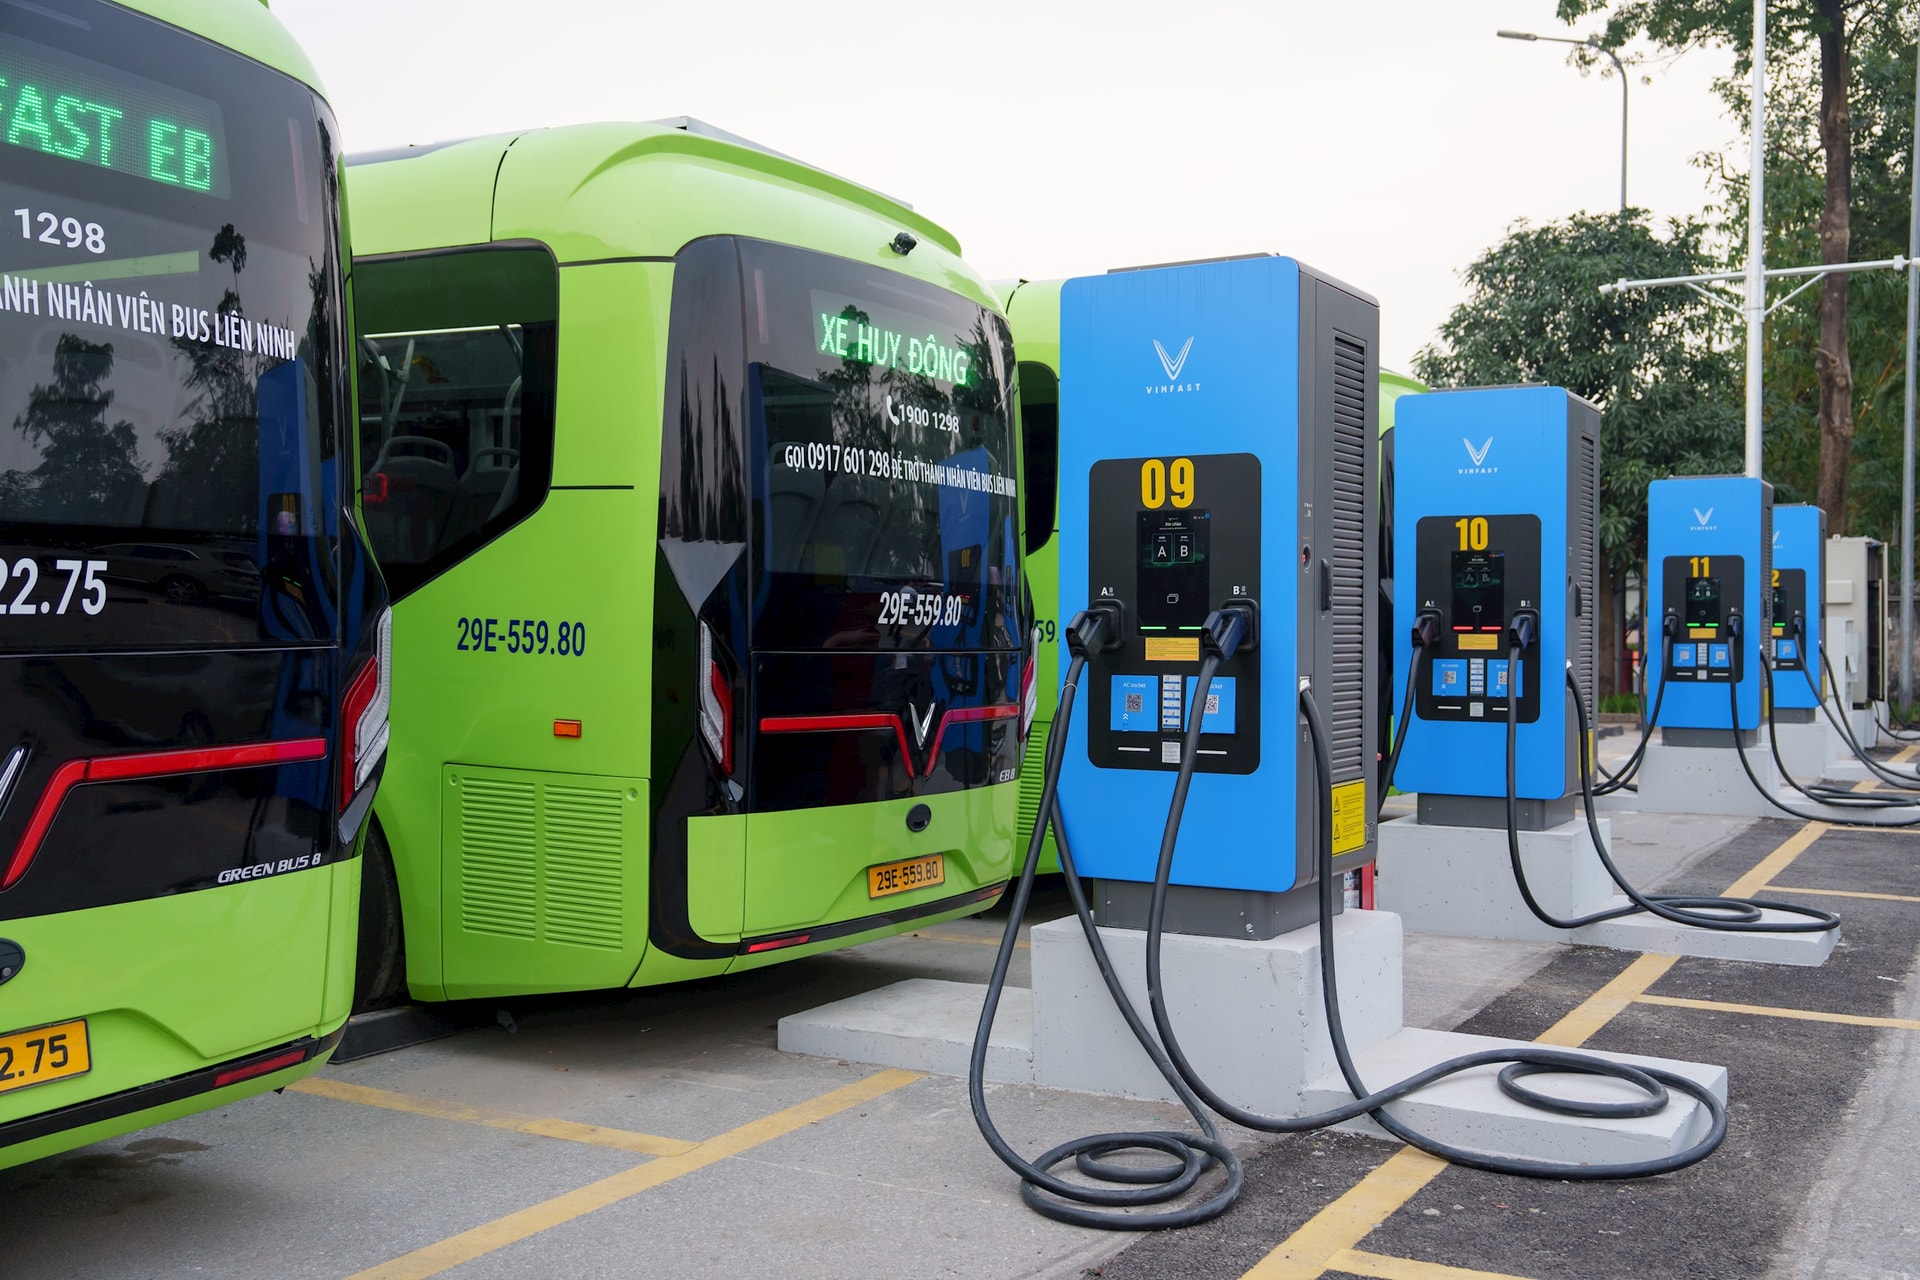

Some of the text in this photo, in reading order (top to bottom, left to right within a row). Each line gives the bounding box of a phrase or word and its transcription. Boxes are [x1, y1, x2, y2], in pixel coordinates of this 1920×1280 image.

[0, 78, 210, 190] AST EB
[14, 208, 106, 254] 1298
[47, 280, 113, 326] NHÂN
[116, 291, 166, 335] VIÊN
[172, 303, 210, 343] BUS
[214, 309, 253, 352] LIÊN
[256, 322, 296, 361] NINH
[820, 313, 849, 356] XE
[857, 323, 901, 368] HUY
[1145, 383, 1201, 394] VINFAST
[899, 404, 960, 434] 1900 1298
[785, 445, 805, 472] GỌI
[807, 442, 840, 472] 0917
[843, 446, 865, 475] 601
[868, 449, 890, 478] 298
[891, 451, 903, 480] ĐỂ
[919, 459, 946, 486] THÀNH
[946, 464, 966, 489] NHÂN
[966, 467, 981, 491] VIÊN
[981, 473, 993, 493] BUS
[1141, 457, 1195, 509] 09
[1458, 467, 1499, 475] VINFAST
[1455, 517, 1489, 551] 10
[1157, 545, 1167, 558] A
[1180, 545, 1189, 557] B
[1689, 557, 1710, 578] 11
[1101, 586, 1109, 596] A
[1232, 586, 1240, 595] B
[877, 591, 962, 626] 29E-559.80
[456, 617, 586, 657] 29E-559.80
[217, 852, 322, 884] GREEN BUS 8
[876, 860, 939, 891] 29E-559.80
